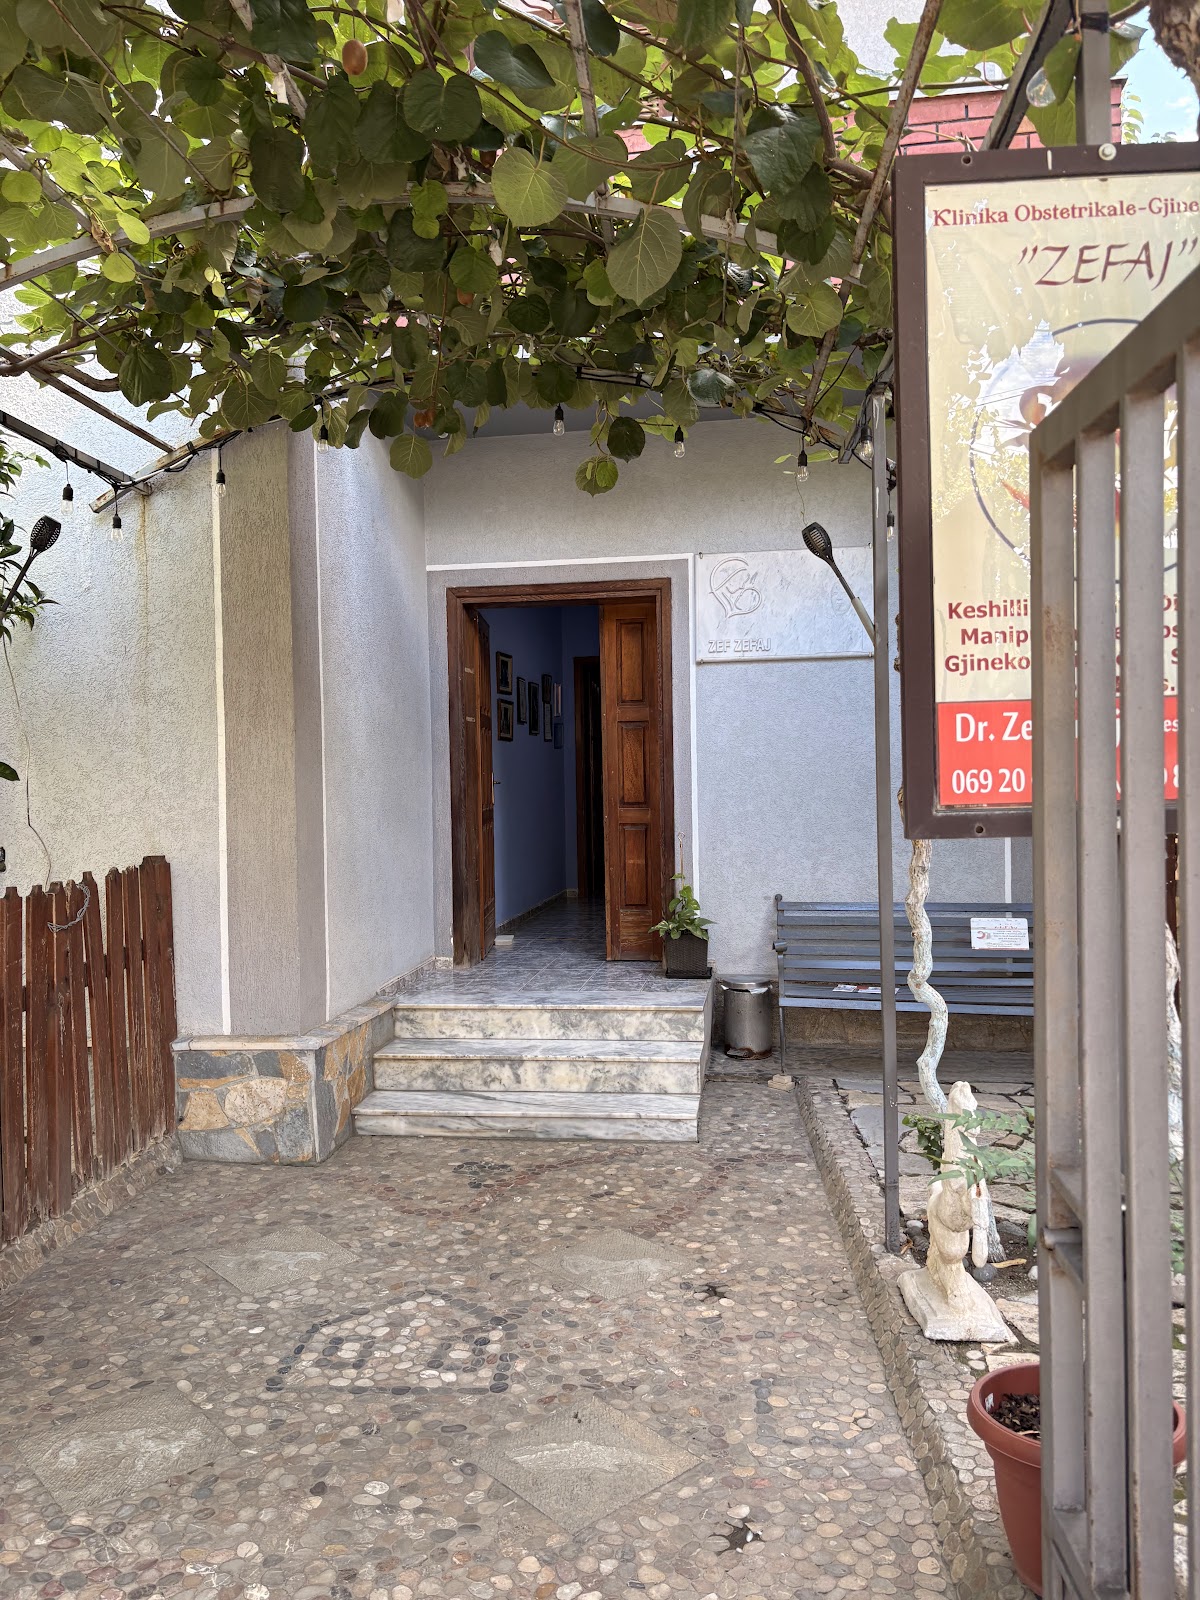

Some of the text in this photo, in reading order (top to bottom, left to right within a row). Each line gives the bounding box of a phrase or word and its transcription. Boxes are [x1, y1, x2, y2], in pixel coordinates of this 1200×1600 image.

[932, 206, 1008, 227] Klinika
[1017, 236, 1198, 291] "ZEFAJ"
[708, 637, 772, 654] ZEF ZEFAJ
[960, 625, 1031, 648] Manip
[955, 712, 995, 743] Dr.
[951, 767, 1026, 795] 069 20
